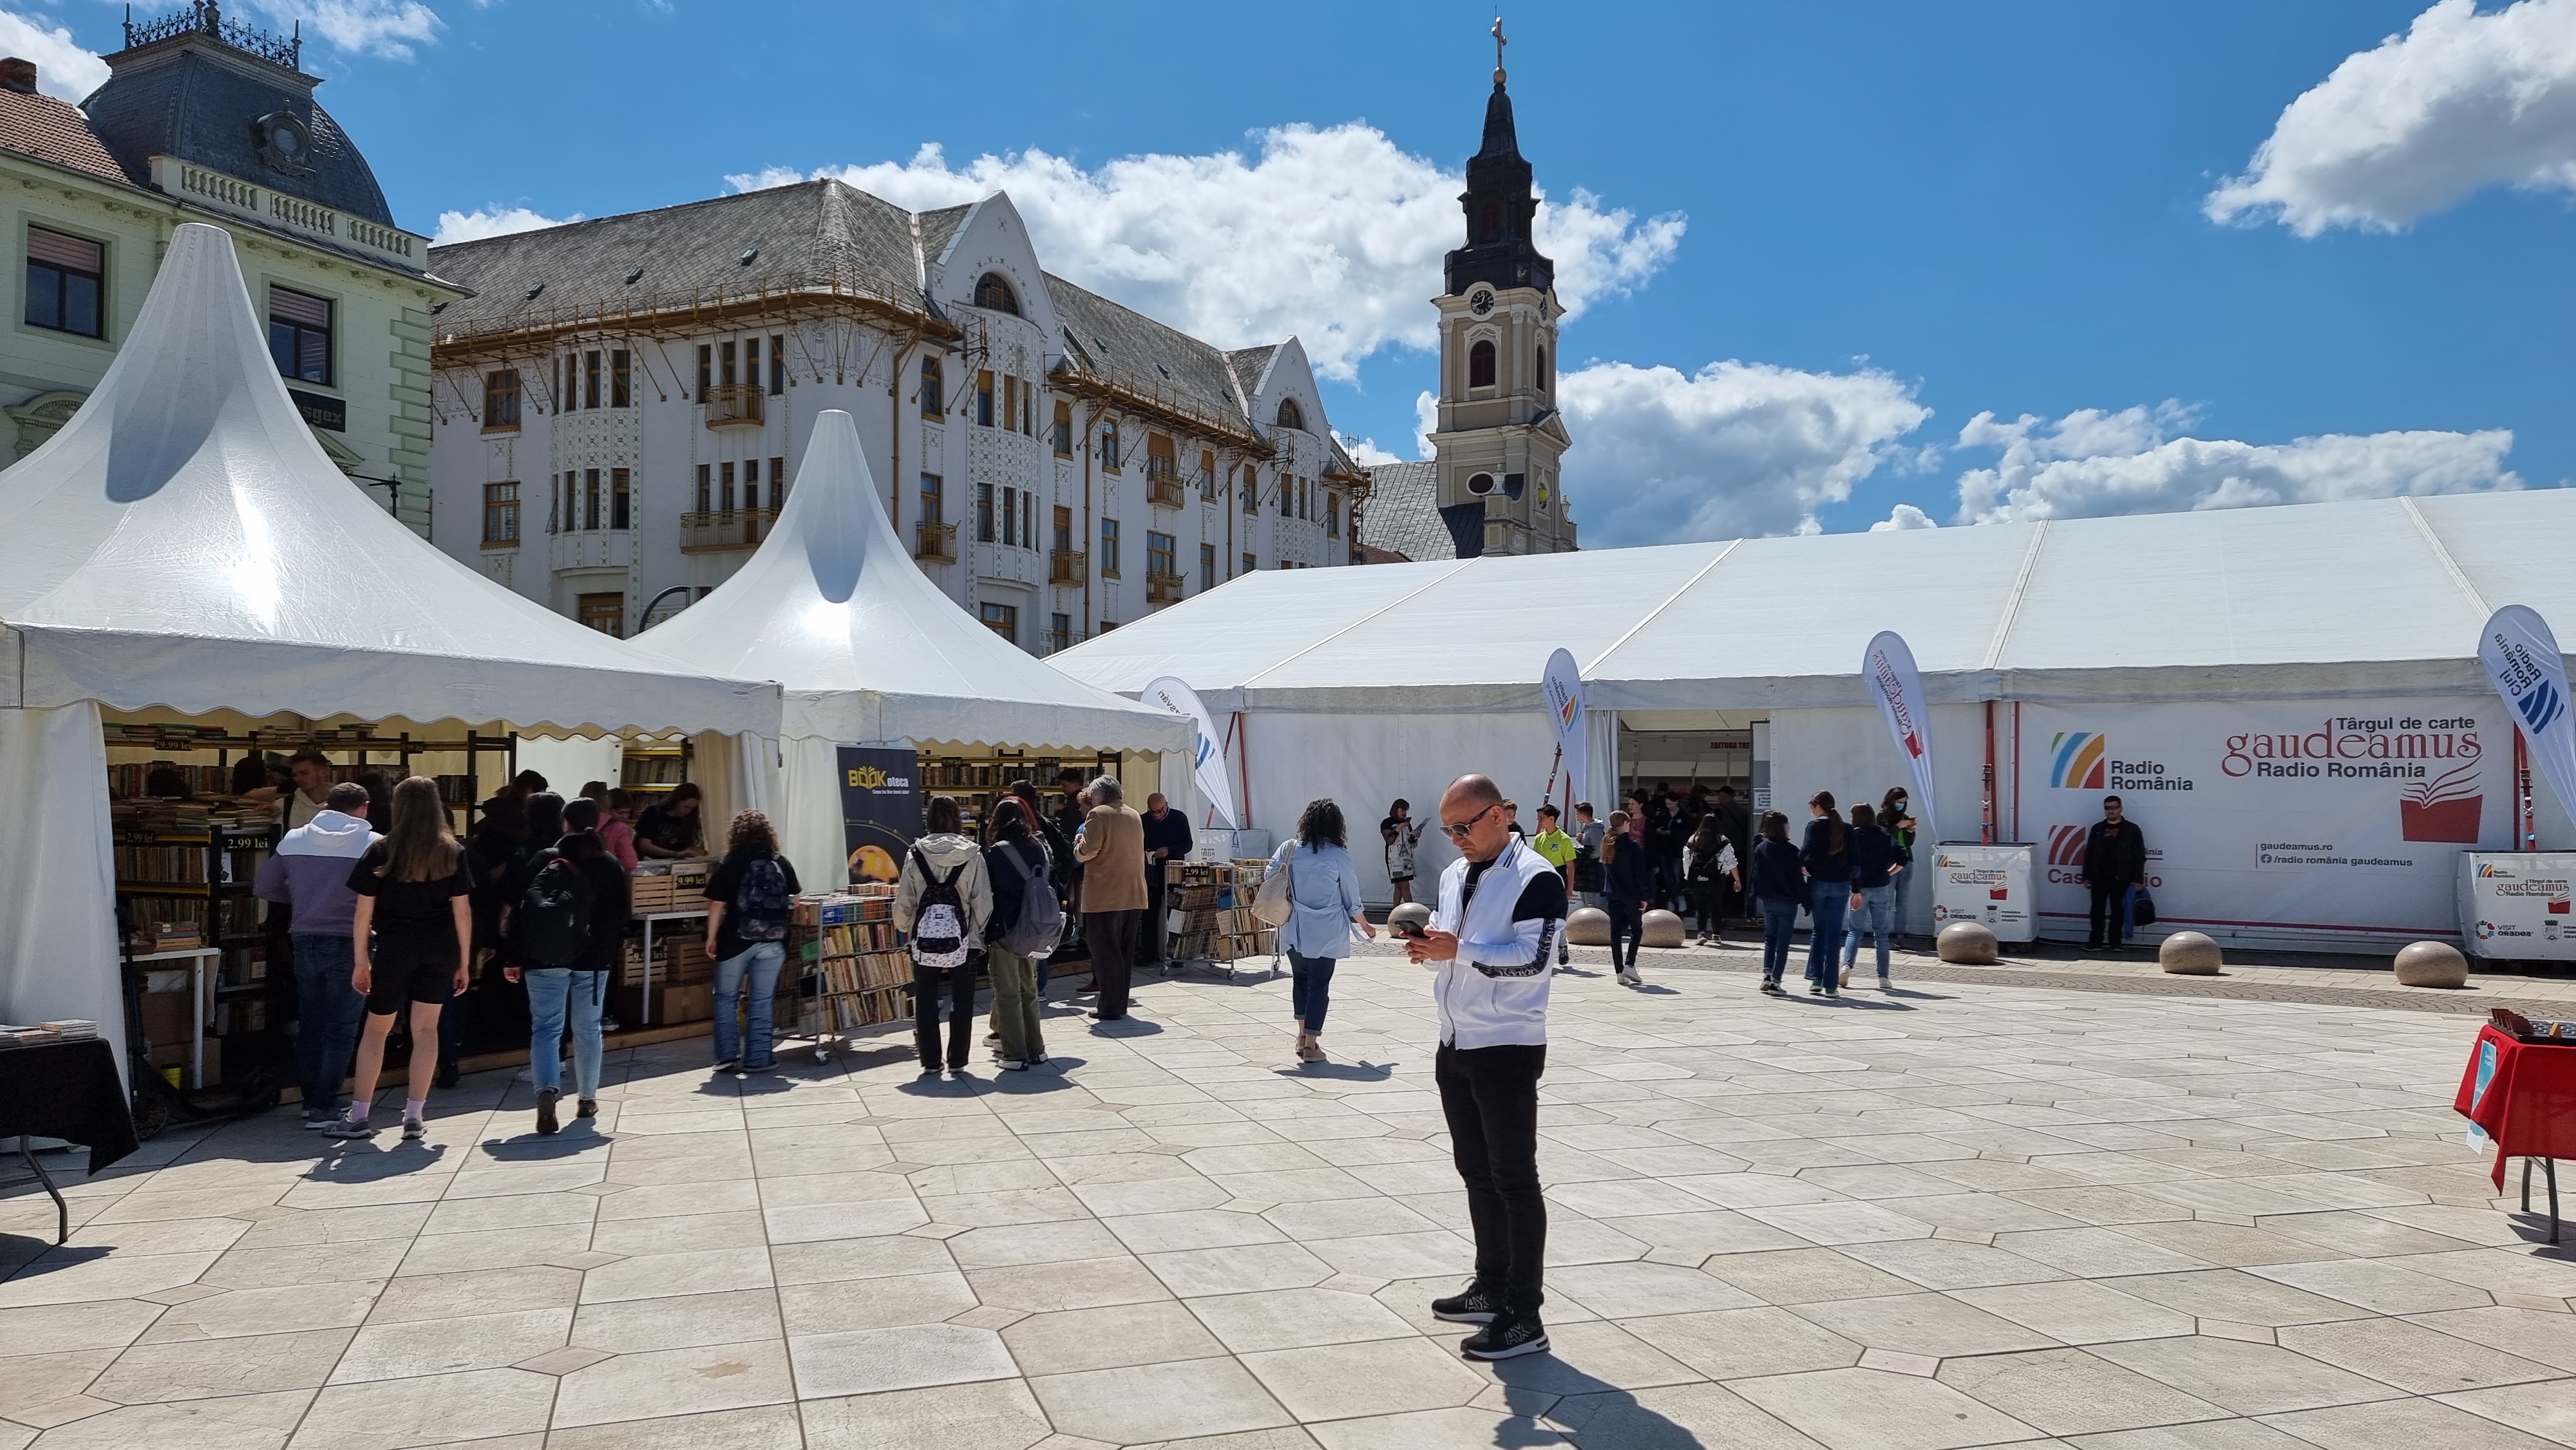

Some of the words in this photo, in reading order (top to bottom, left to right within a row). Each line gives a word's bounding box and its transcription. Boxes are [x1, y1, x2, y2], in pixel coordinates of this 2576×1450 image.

[2336, 717, 2393, 733] Târgul
[2400, 717, 2422, 730] de
[2428, 717, 2476, 730] carte
[2221, 717, 2482, 777] gaudeamus
[2111, 760, 2165, 775] Radio
[2257, 762, 2320, 778] Radio
[2327, 762, 2426, 778] România
[2111, 776, 2194, 791] România
[227, 838, 251, 849] 2.99
[255, 838, 269, 848] lei
[2260, 842, 2333, 851] gaudeamus.ro
[2145, 847, 2163, 856] ânia
[2306, 856, 2347, 865] românia
[2351, 857, 2413, 867] gaudeamus
[678, 877, 694, 885] 9.99
[1950, 869, 2008, 884] gaudeamus
[2048, 869, 2084, 885] Cas
[2496, 879, 2570, 896] gaudeamus
